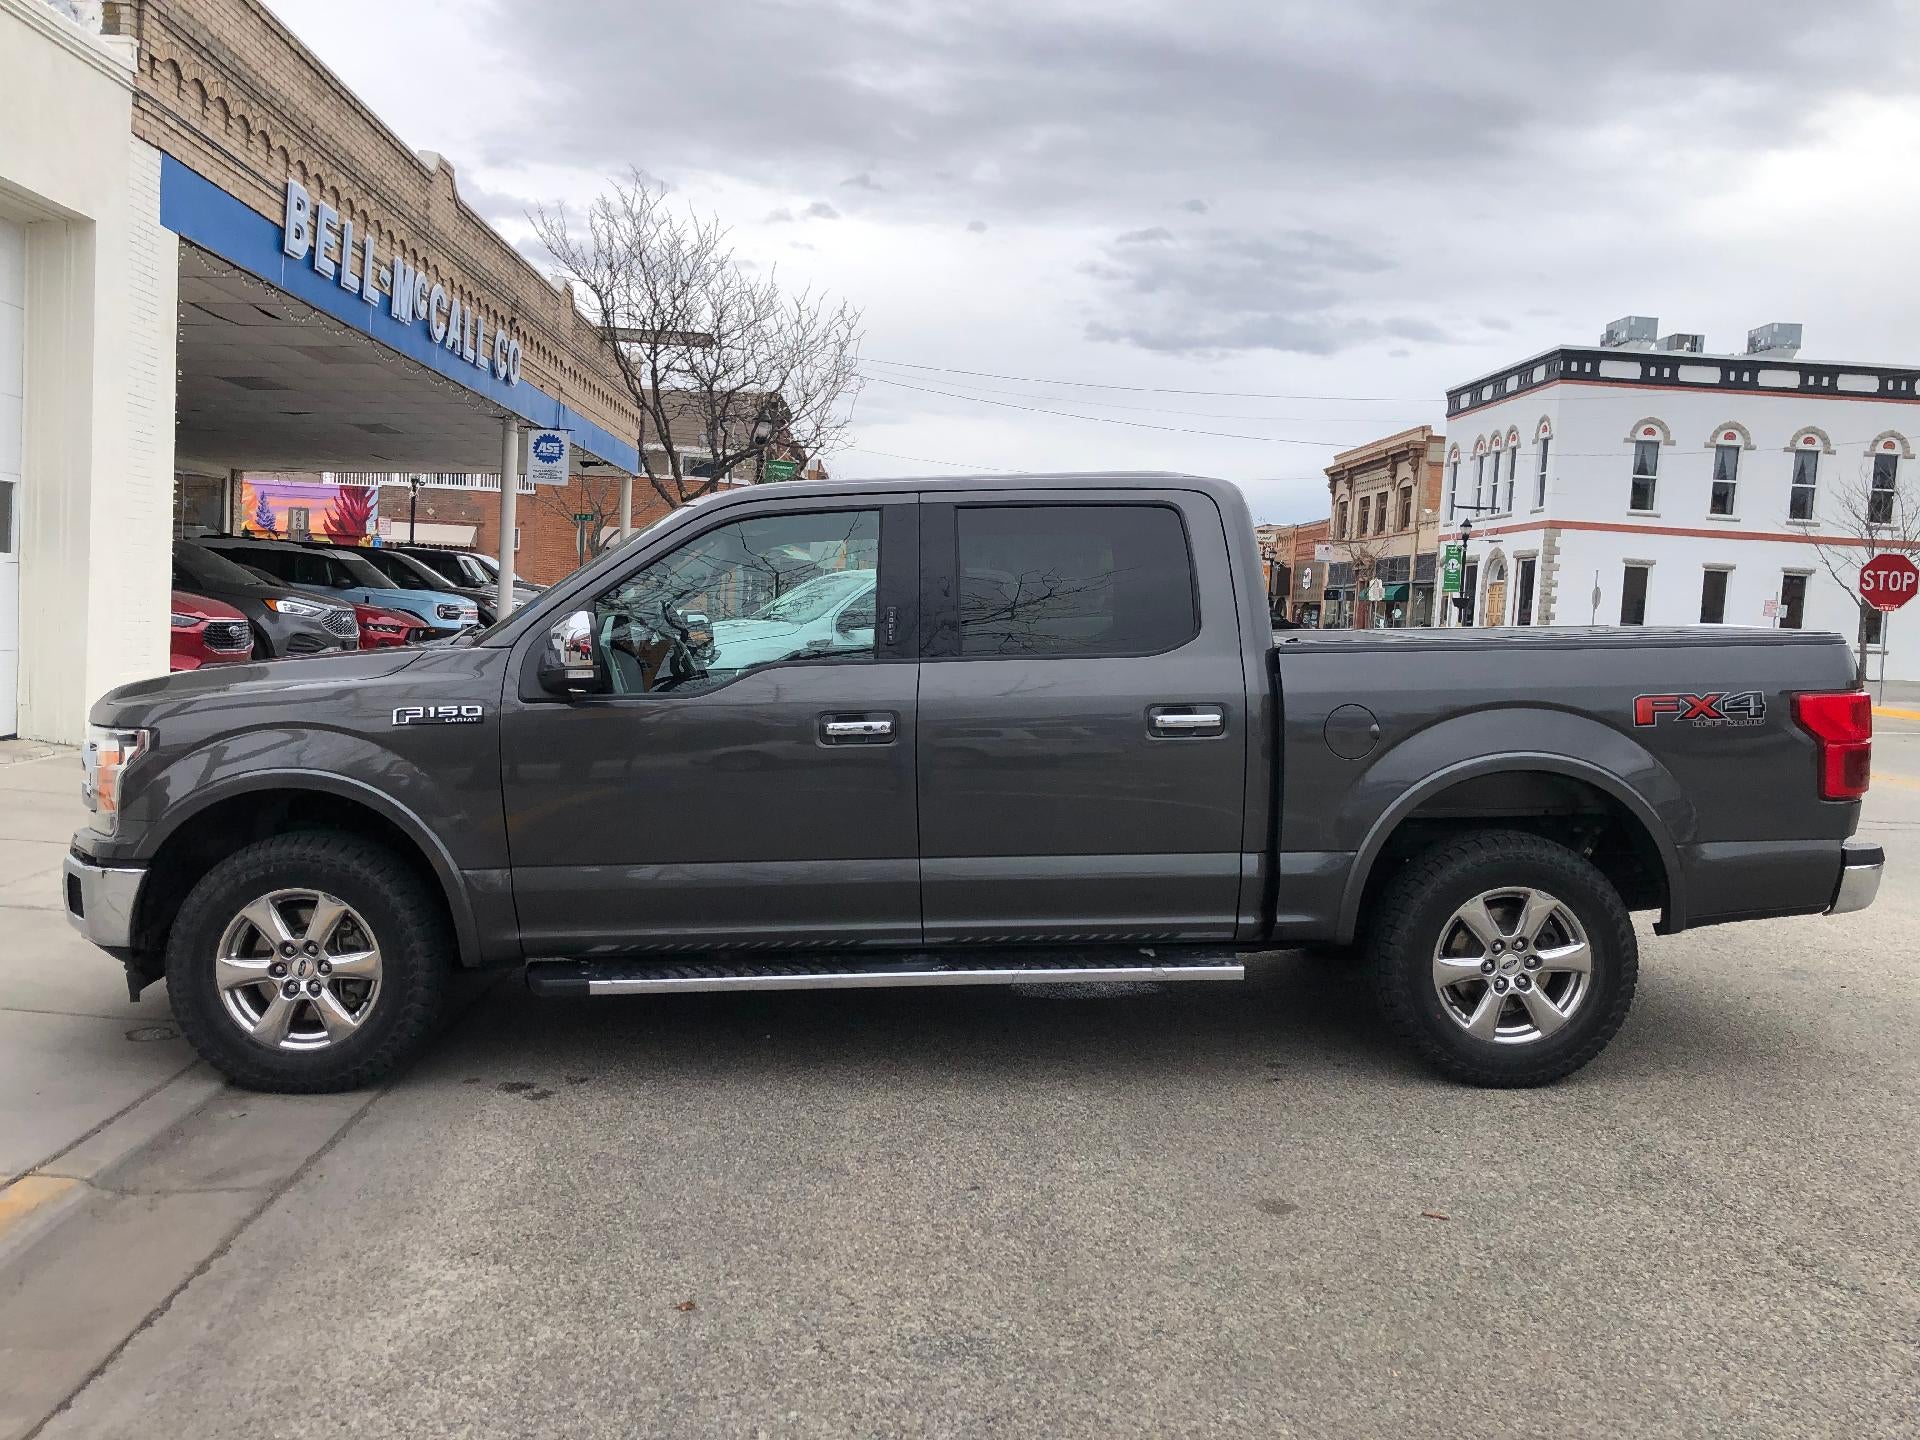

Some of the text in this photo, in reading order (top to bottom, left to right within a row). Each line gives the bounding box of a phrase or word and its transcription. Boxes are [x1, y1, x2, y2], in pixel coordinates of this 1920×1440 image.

[493, 329, 522, 388] CO
[537, 442, 560, 454] ASE
[1861, 569, 1916, 592] STOP
[1633, 691, 1767, 728] FX4
[1693, 719, 1766, 728] OFF ROAD
